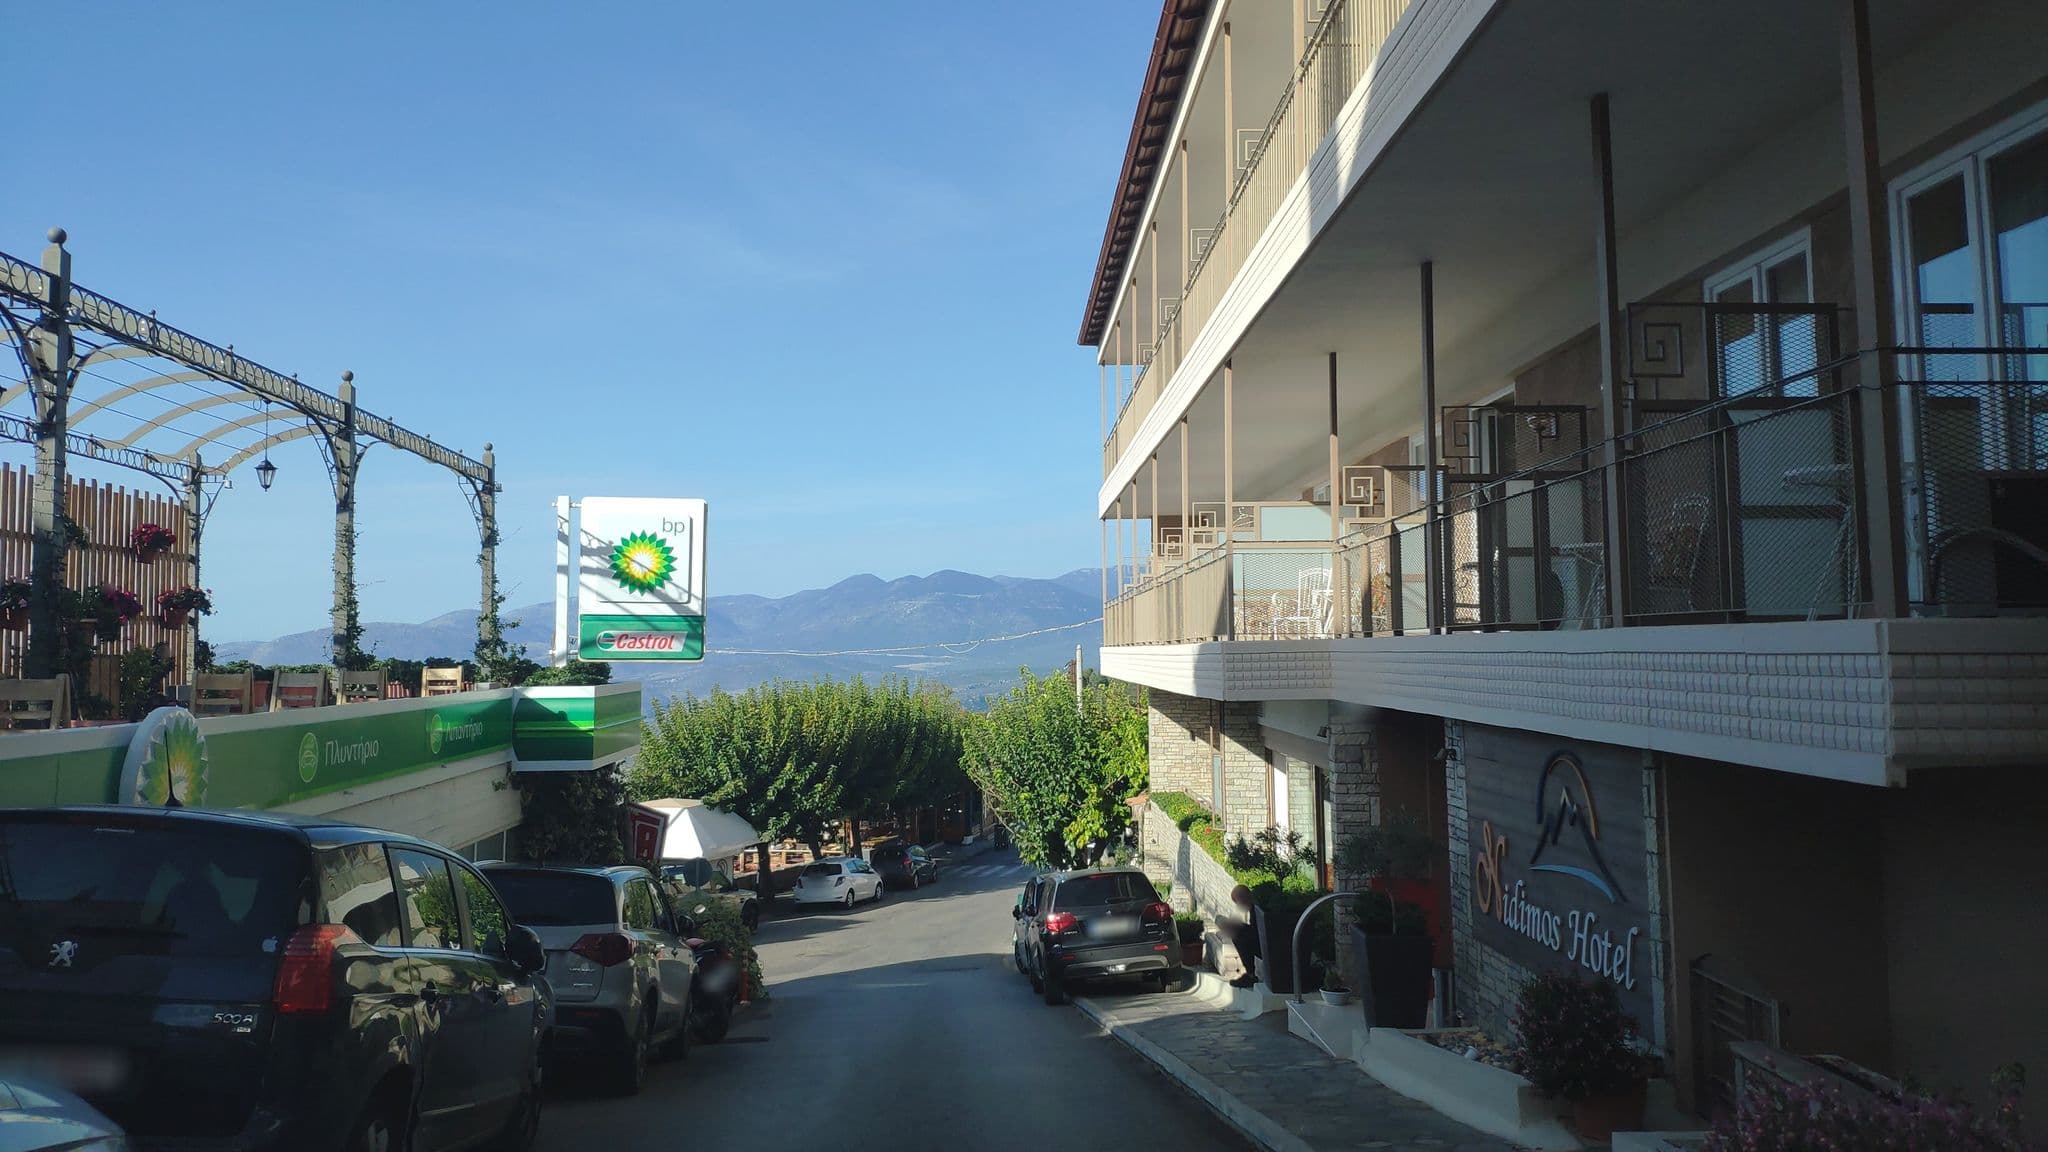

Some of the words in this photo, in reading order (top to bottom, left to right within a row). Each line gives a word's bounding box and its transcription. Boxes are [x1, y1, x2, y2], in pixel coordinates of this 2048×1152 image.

[662, 517, 685, 536] bp
[615, 633, 675, 650] Castrol
[325, 736, 379, 768] Πλυντήριο
[1476, 821, 1561, 951] Nidimos
[1567, 909, 1640, 991] Hotel
[211, 1012, 254, 1025] 5008
